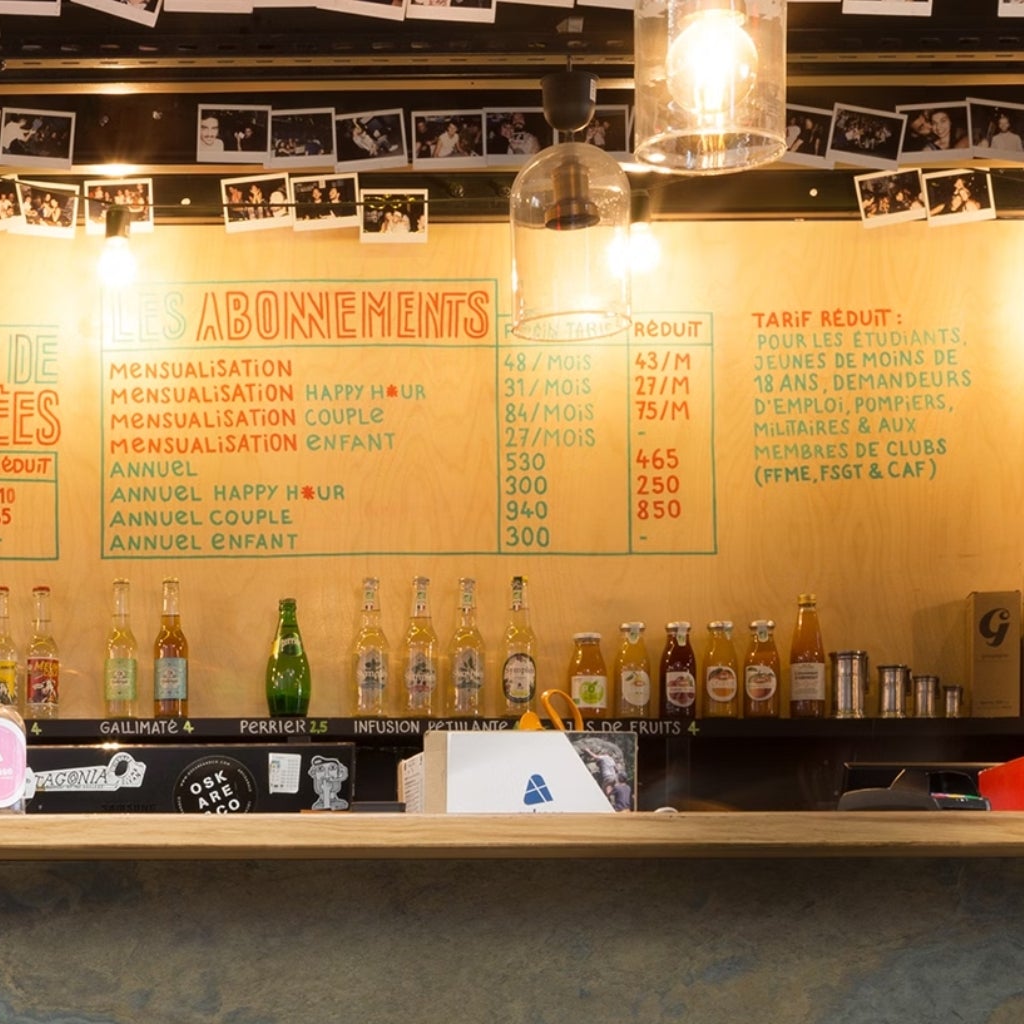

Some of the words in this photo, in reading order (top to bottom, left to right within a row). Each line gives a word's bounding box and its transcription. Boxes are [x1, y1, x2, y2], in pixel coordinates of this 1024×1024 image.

[111, 291, 187, 342] LES
[196, 290, 489, 341] ABONNEMENTS
[757, 332, 807, 350] POUR
[813, 332, 843, 348] LES
[7, 333, 59, 385] DE
[754, 352, 827, 371] JEUNES
[835, 353, 857, 369] DE
[934, 349, 959, 366] DE
[754, 374, 773, 393] 18
[834, 370, 972, 391] DEMANDEURS
[306, 385, 364, 401] HAPPY
[858, 417, 872, 434] &
[878, 417, 916, 433] AUX
[636, 448, 679, 469] 465
[754, 442, 849, 460] MEMBRES
[856, 442, 879, 458] DE
[886, 438, 947, 457] CLUBS
[506, 452, 546, 471] 530
[868, 463, 884, 480] &
[213, 484, 279, 501] HAPPY
[505, 475, 548, 495] 300
[637, 475, 680, 496] 250
[210, 508, 293, 526] COUPLE
[505, 500, 548, 521] 940
[637, 500, 681, 520] 850
[506, 526, 549, 547] 300
[31, 723, 43, 736] 4
[183, 721, 195, 735] 4
[354, 720, 420, 734] INFUSION
[630, 720, 681, 735] FRUITS
[688, 721, 700, 736] 4
